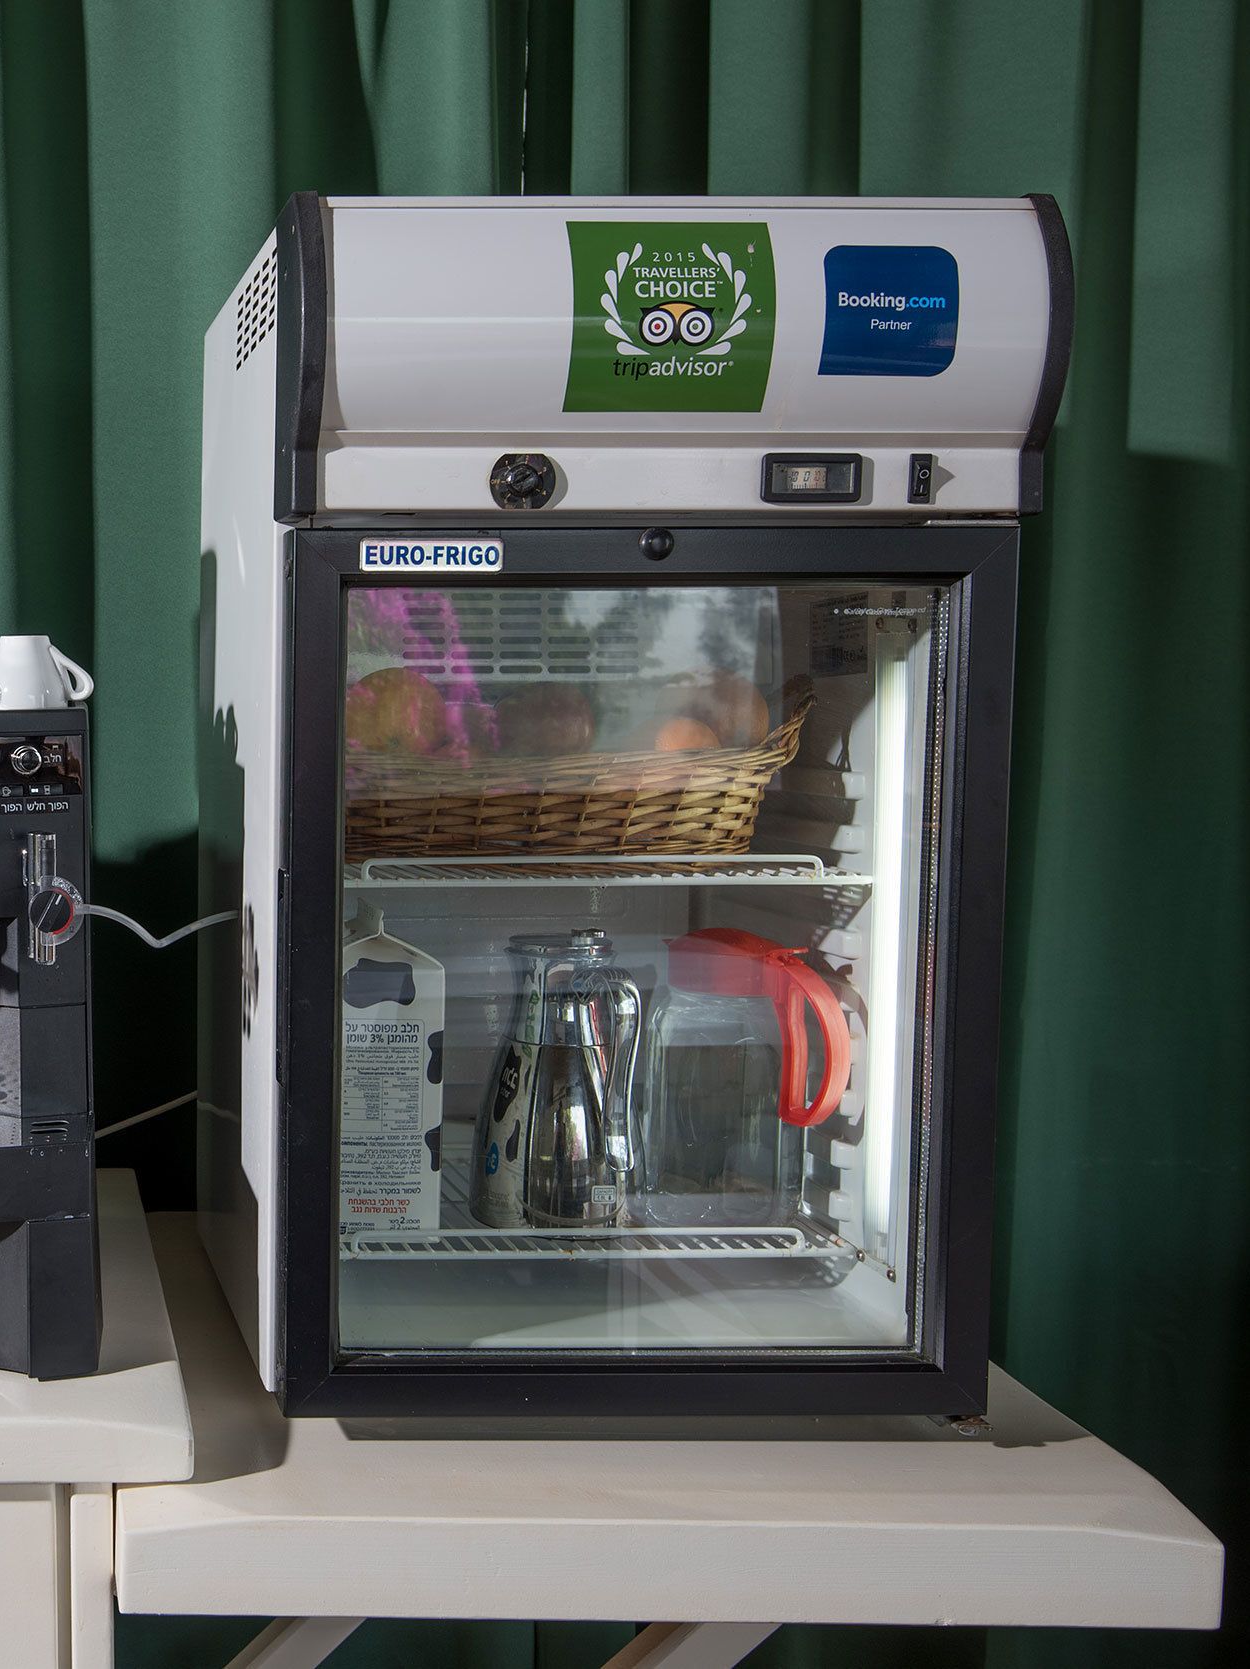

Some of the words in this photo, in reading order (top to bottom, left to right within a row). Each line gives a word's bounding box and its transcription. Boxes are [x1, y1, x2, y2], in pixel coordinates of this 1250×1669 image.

[652, 252, 696, 262] 2015
[838, 291, 946, 311] Booking.com
[870, 318, 912, 331] Partner
[365, 545, 500, 566] EURO-FRIGO
[44, 753, 62, 764] חלב
[1, 803, 22, 813] הפוך
[26, 801, 46, 811] חלש
[48, 801, 69, 812] הפוך
[345, 1021, 358, 1033] על
[360, 1023, 398, 1033] מפוסטר
[401, 1022, 420, 1033] חלב
[346, 1034, 368, 1045] שומן
[370, 1033, 385, 1043] 3%
[378, 1198, 395, 1206] חלבי
[399, 1216, 406, 1224] 2
